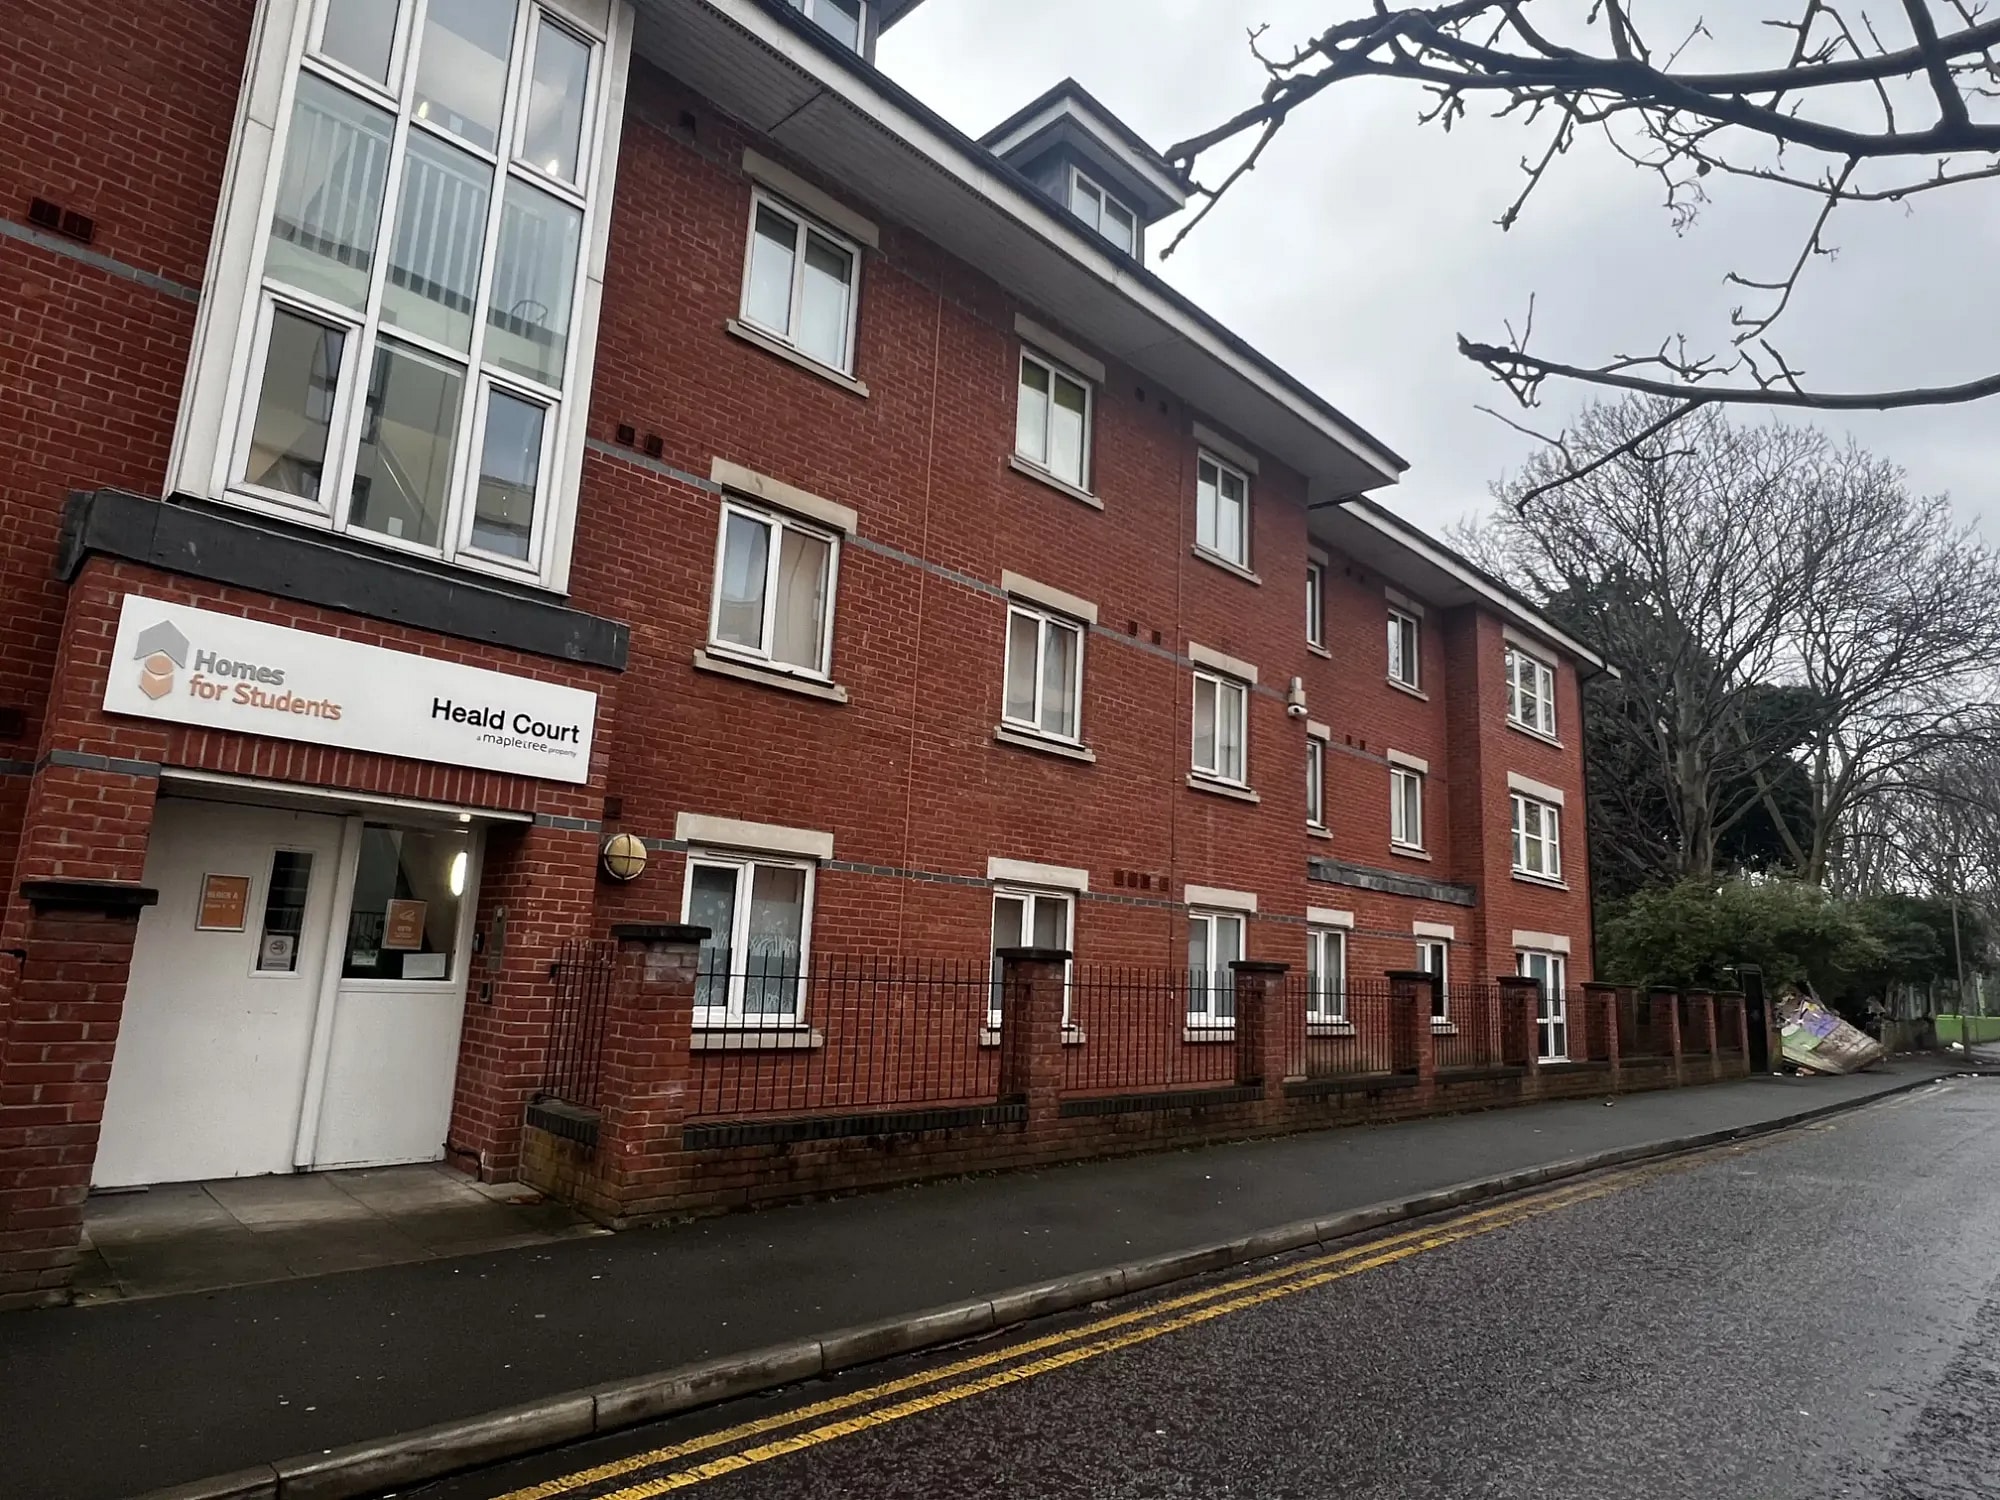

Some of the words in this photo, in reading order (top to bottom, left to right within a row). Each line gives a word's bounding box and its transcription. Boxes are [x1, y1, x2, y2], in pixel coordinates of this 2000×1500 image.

[194, 649, 285, 685] Homes
[189, 674, 231, 700] for
[232, 682, 342, 720] Students
[431, 697, 505, 730] Heald
[512, 713, 580, 743] Court
[483, 733, 548, 752] mapletree
